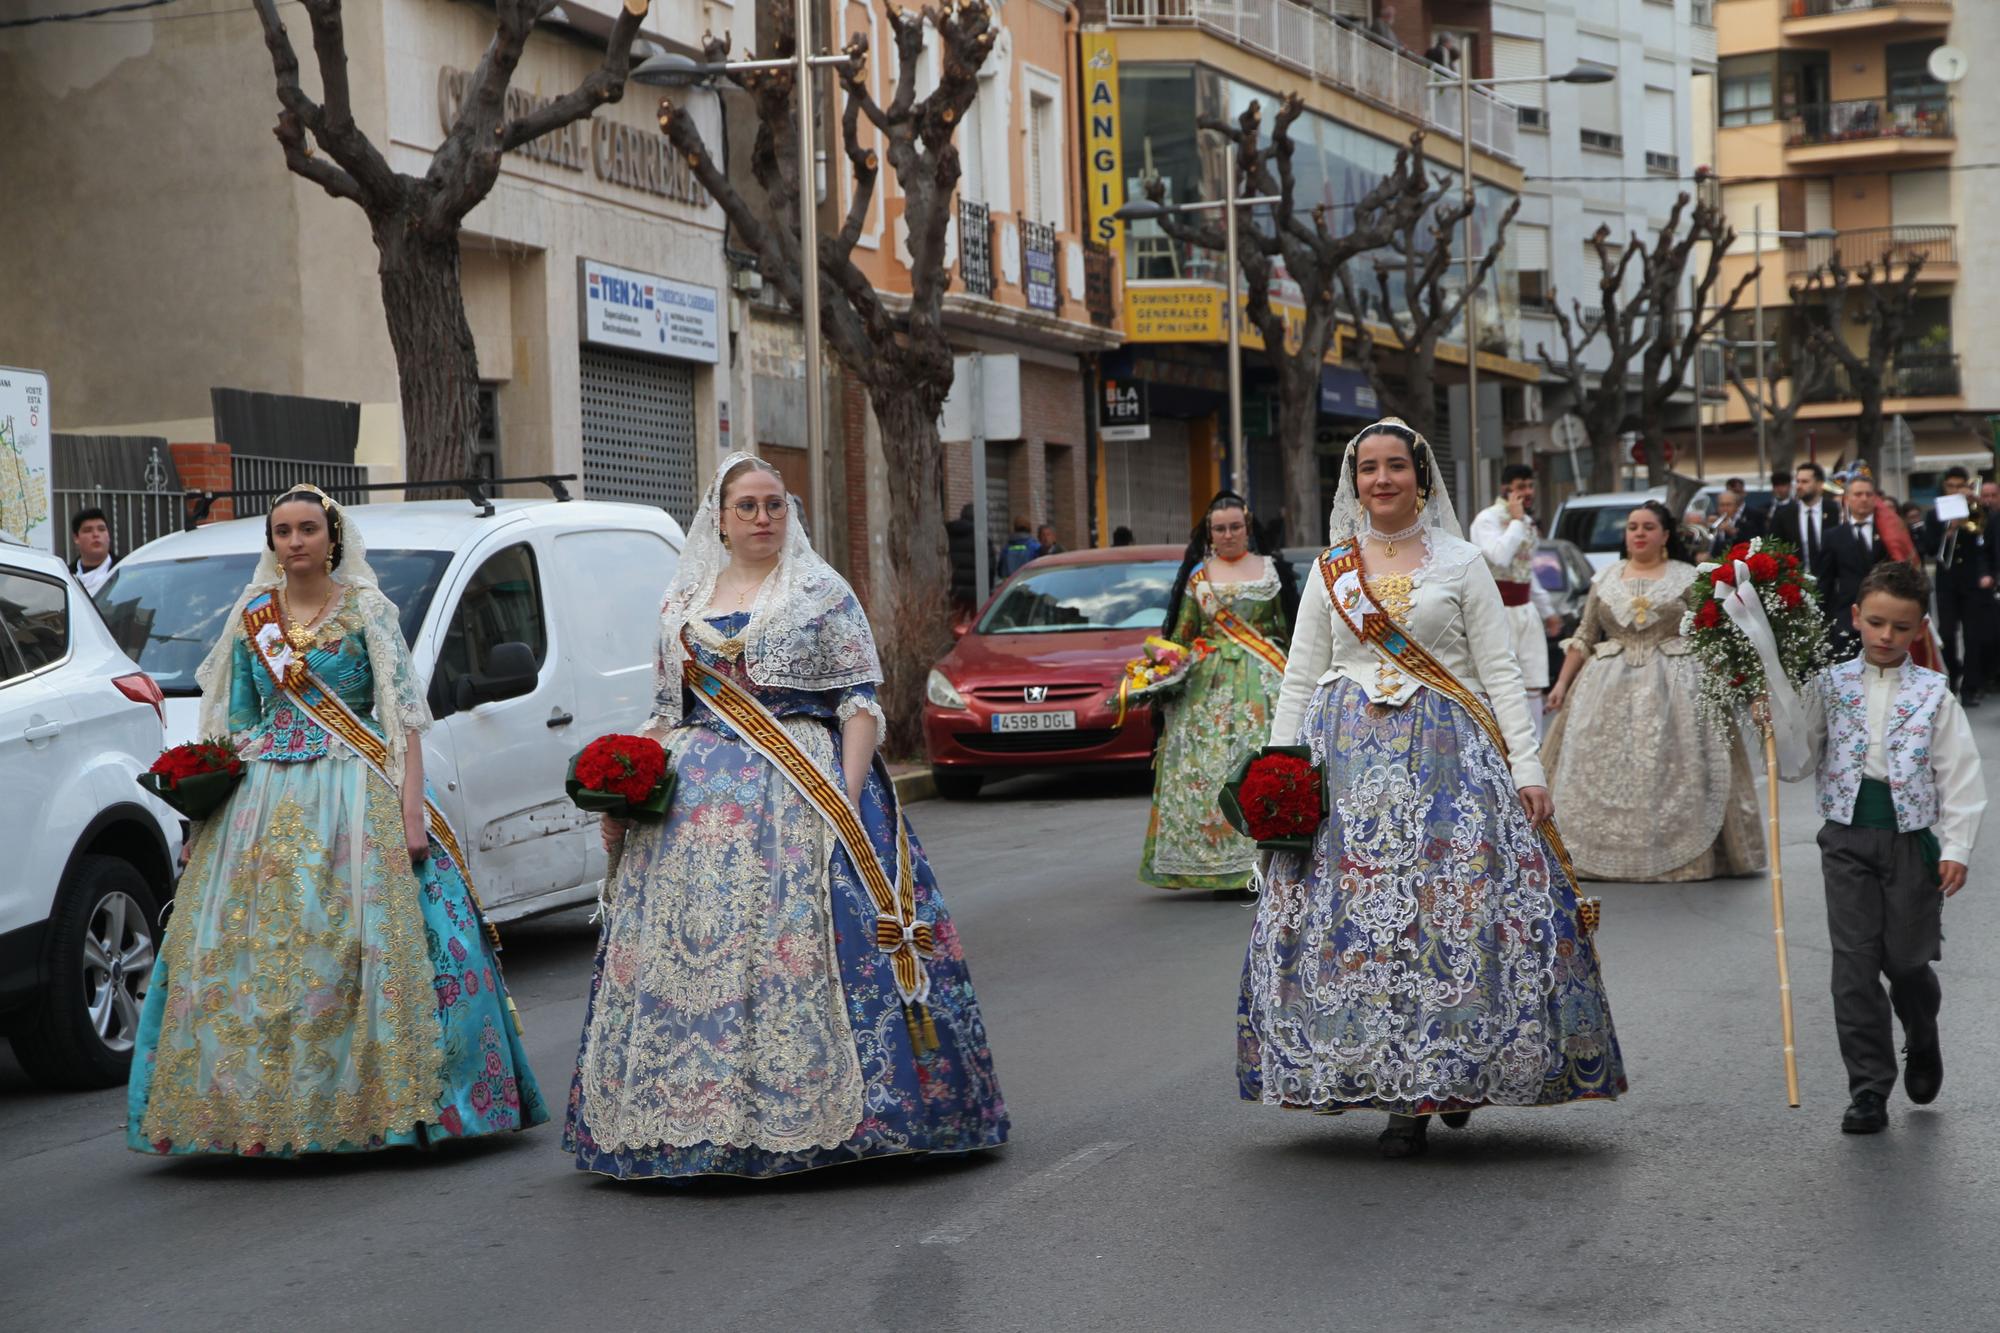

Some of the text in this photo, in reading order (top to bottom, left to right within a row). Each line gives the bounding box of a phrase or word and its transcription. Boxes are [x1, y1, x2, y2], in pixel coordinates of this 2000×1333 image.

[1091, 80, 1116, 240] ANGIS
[601, 275, 643, 309] TIEN 21
[1132, 293, 1213, 304] SUMINISTROS
[1136, 307, 1208, 319] GENERALES
[1137, 322, 1208, 334] DE PINTURA
[1106, 402, 1139, 416] TEM
[1001, 713, 1071, 730] 4598 DGL
